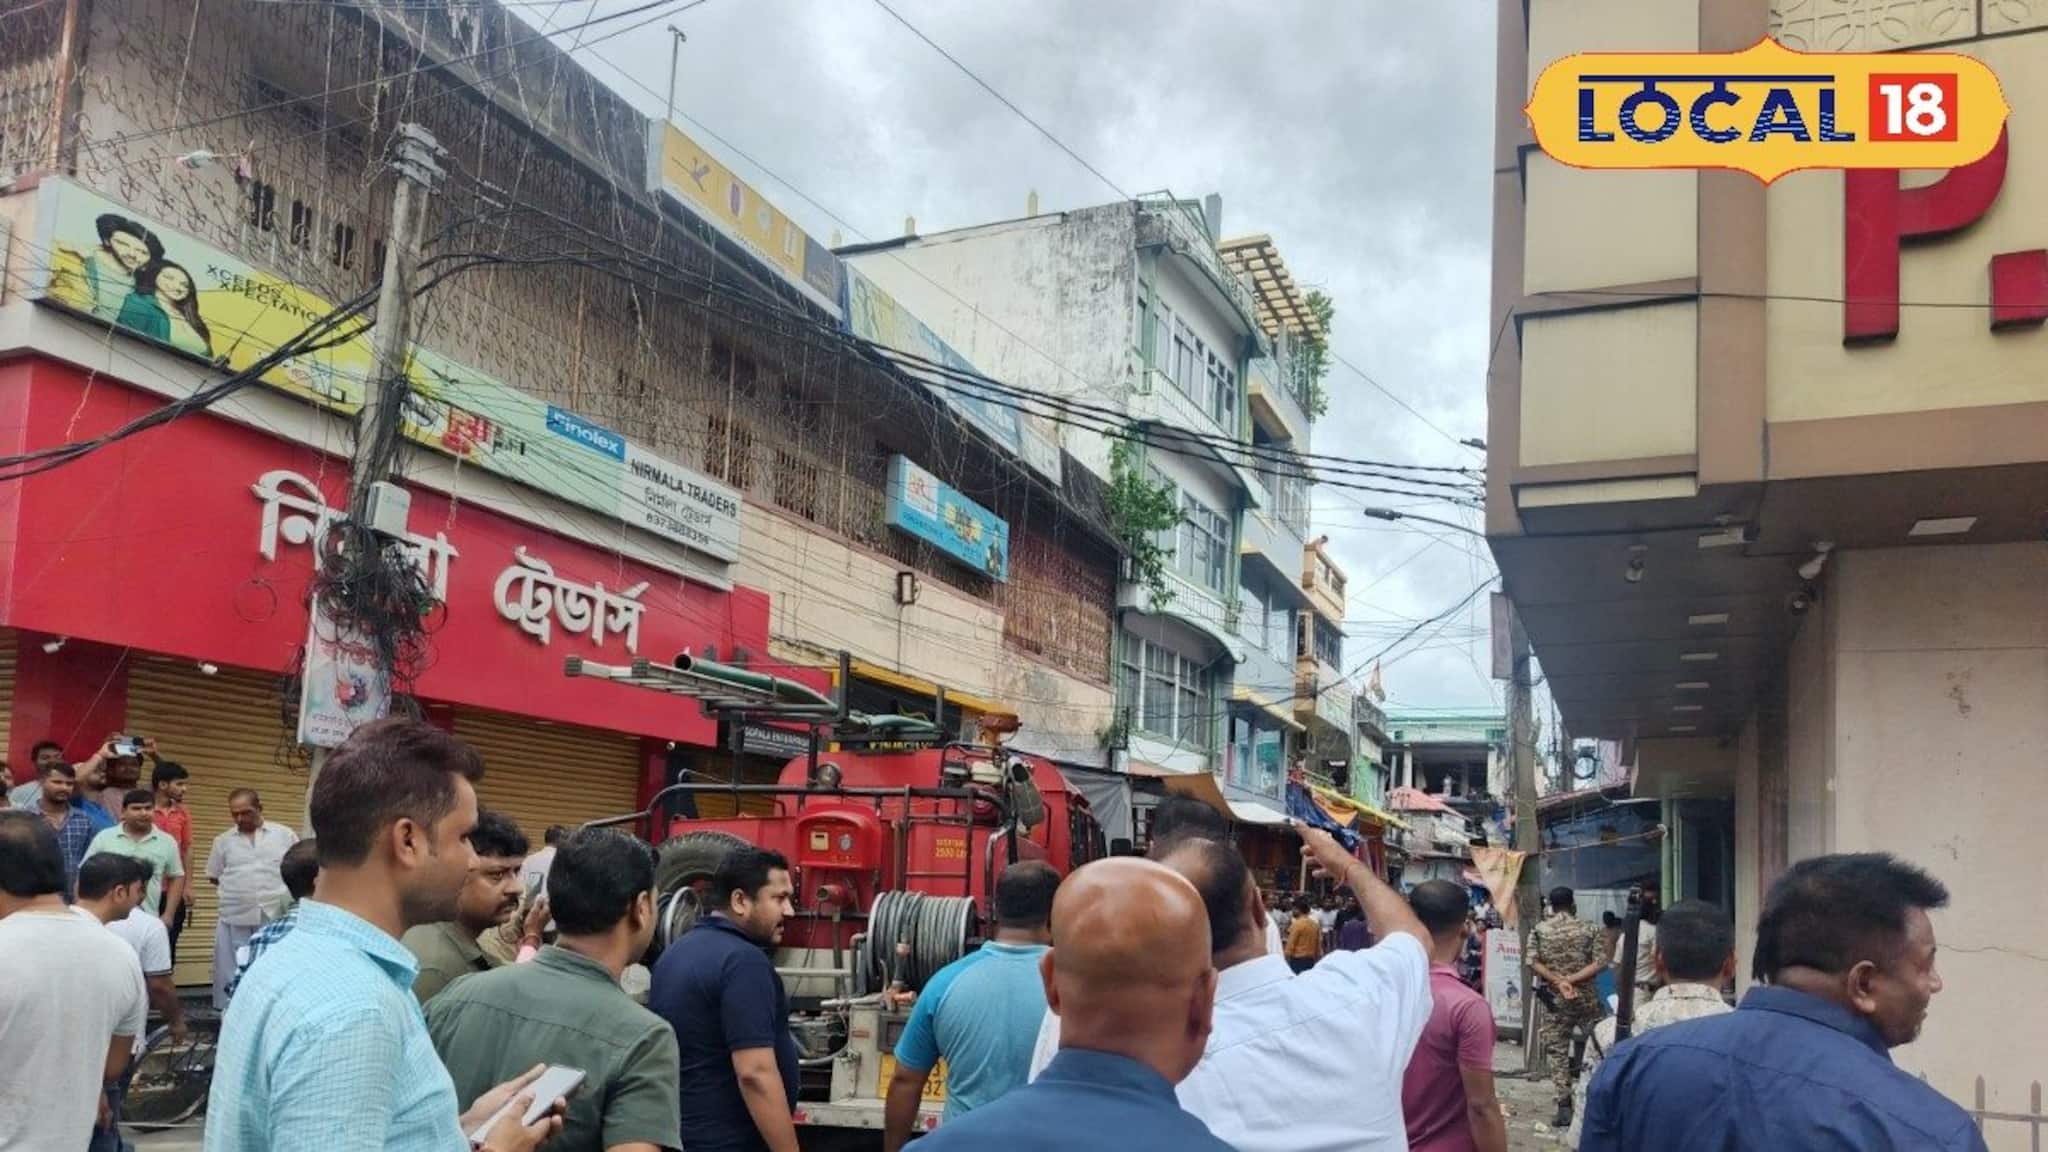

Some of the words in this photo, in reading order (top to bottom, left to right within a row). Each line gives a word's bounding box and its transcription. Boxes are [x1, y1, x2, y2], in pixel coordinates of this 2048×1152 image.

[206, 264, 282, 299] XCEEDS
[220, 280, 336, 329] XPECTATIO
[630, 458, 686, 496] NIRMALA
[686, 482, 737, 519] TRADERS
